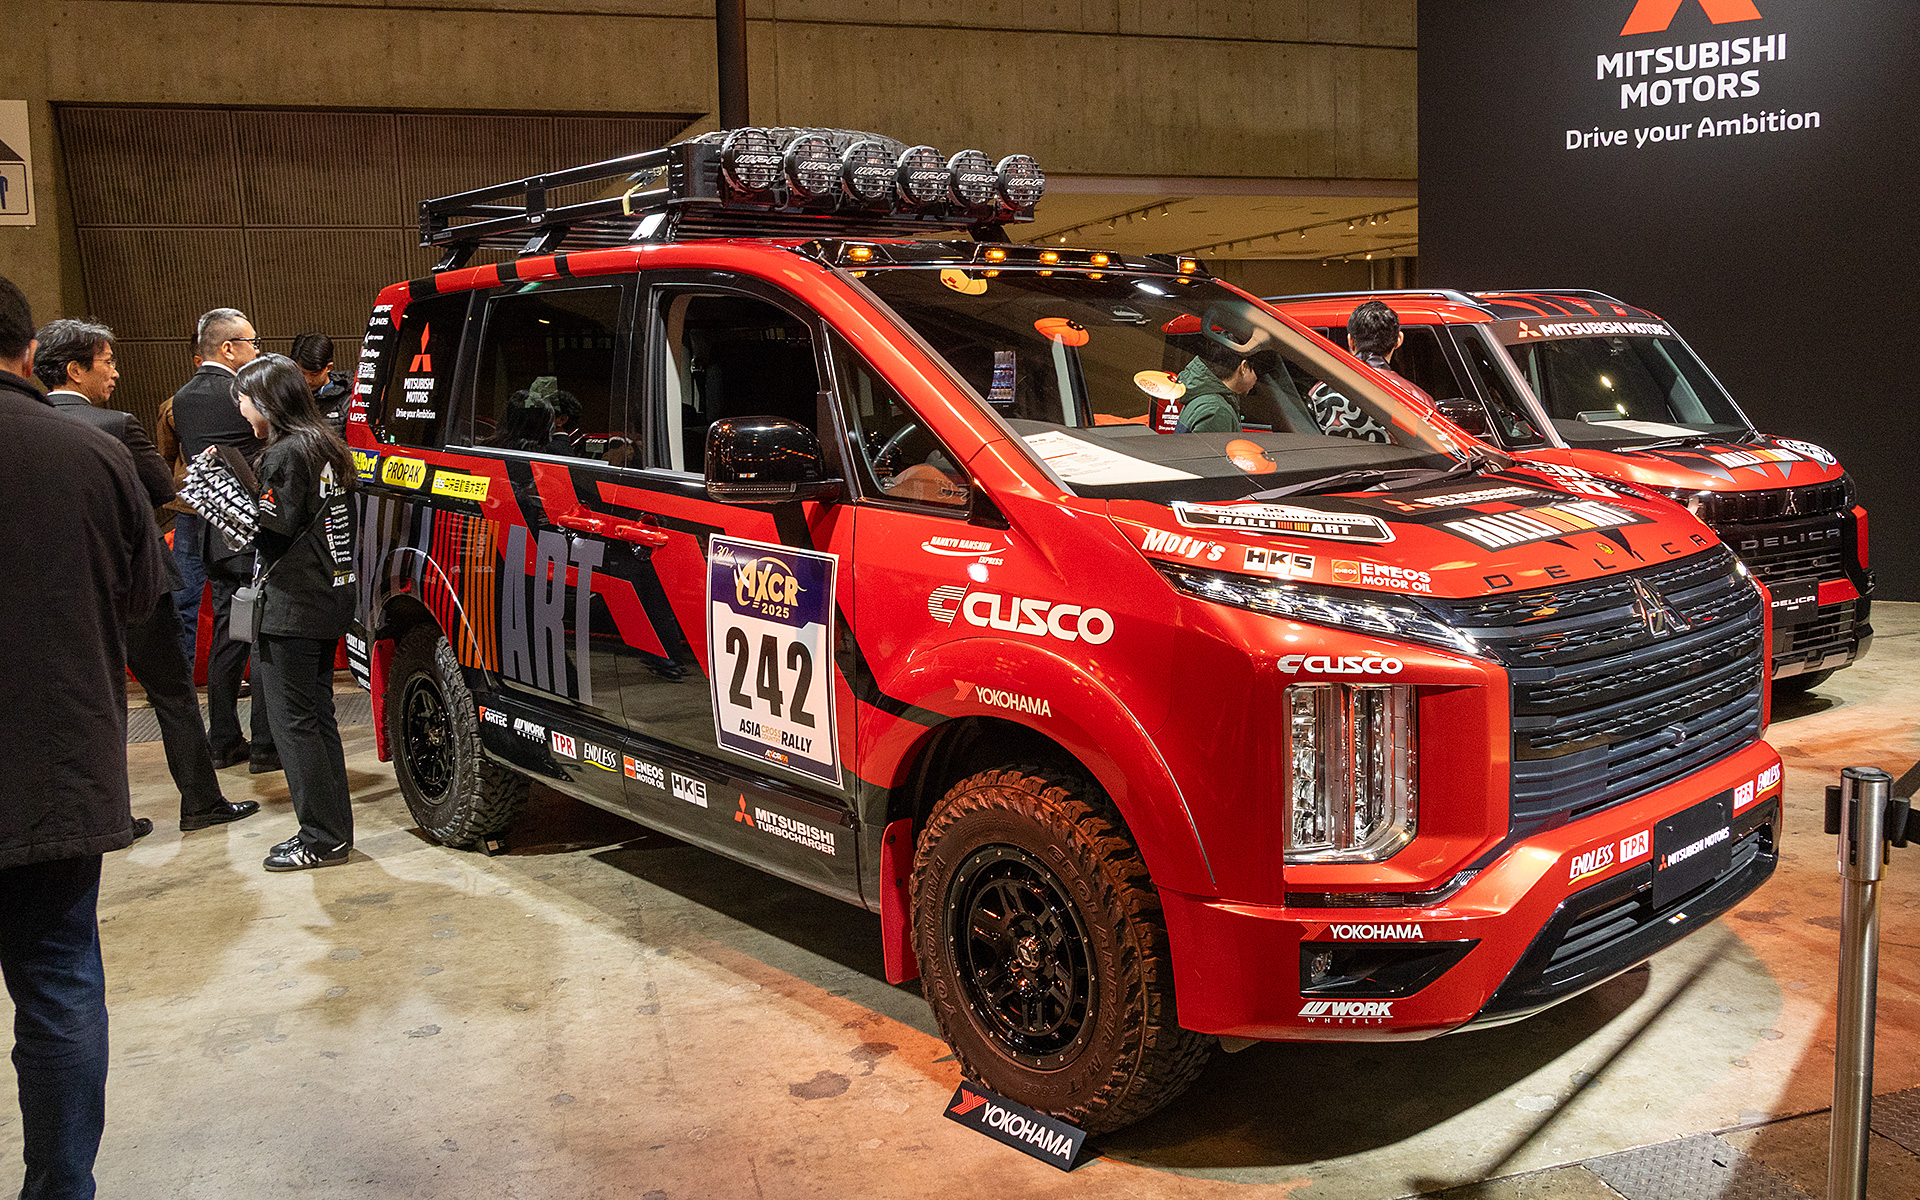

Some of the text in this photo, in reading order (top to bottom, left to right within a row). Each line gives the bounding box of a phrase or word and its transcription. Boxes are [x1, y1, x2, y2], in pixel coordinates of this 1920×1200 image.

[1597, 34, 1787, 80] MITSUBISHI
[1620, 69, 1760, 109] MOTORS
[1566, 108, 1821, 150] Drive your Ambition
[1539, 322, 1671, 337] MITSUBISHI MOTORS
[403, 378, 434, 390] MITSUBISHI
[406, 391, 429, 403] MOTORS
[395, 408, 436, 420] Drive your Ambition
[386, 461, 422, 483] PROPAK
[1217, 515, 1352, 535] RALLI ART
[930, 536, 992, 551] HANKYU HANSHIN
[1141, 528, 1226, 562] Moty's
[1741, 528, 1841, 551] DELICA
[978, 556, 1004, 566] EXPRESS
[1246, 549, 1313, 570] HKS
[1334, 567, 1358, 575] ENEOS
[1482, 534, 1707, 590] DELICA
[735, 558, 799, 607] AXCR
[1360, 562, 1432, 583] ENEOS
[1362, 575, 1433, 594] MOTOR OIL
[761, 602, 790, 619] 2025
[1771, 595, 1816, 608] DELICA
[502, 523, 606, 707] ART
[962, 591, 1115, 645] CUSCO
[1303, 656, 1404, 675] CUSCO
[725, 626, 816, 729] 242
[975, 685, 1051, 718] YOKOHAMA
[479, 705, 508, 728] FORTEC
[525, 721, 546, 739] WORK
[739, 718, 813, 754] ASIA CROSS RALLY
[553, 732, 575, 757] TPR
[584, 742, 617, 769] ENDLESS
[635, 759, 664, 781] ENEOS
[637, 772, 666, 790] MOTOR OIL
[1756, 762, 1781, 792] ENDLESS
[672, 775, 706, 800] HKS
[1736, 783, 1752, 806] TPR
[754, 807, 835, 846] MITSUBISHI
[756, 819, 836, 856] TURBOCHARGER
[1623, 834, 1646, 861] TPR
[1667, 826, 1730, 867] MITSUBISHI MOTORS
[1569, 843, 1615, 879] ENDLESS
[1330, 923, 1424, 939] YOKOHAMA
[1329, 1002, 1394, 1017] WORK
[980, 1102, 1074, 1160] YOKOHAMA
